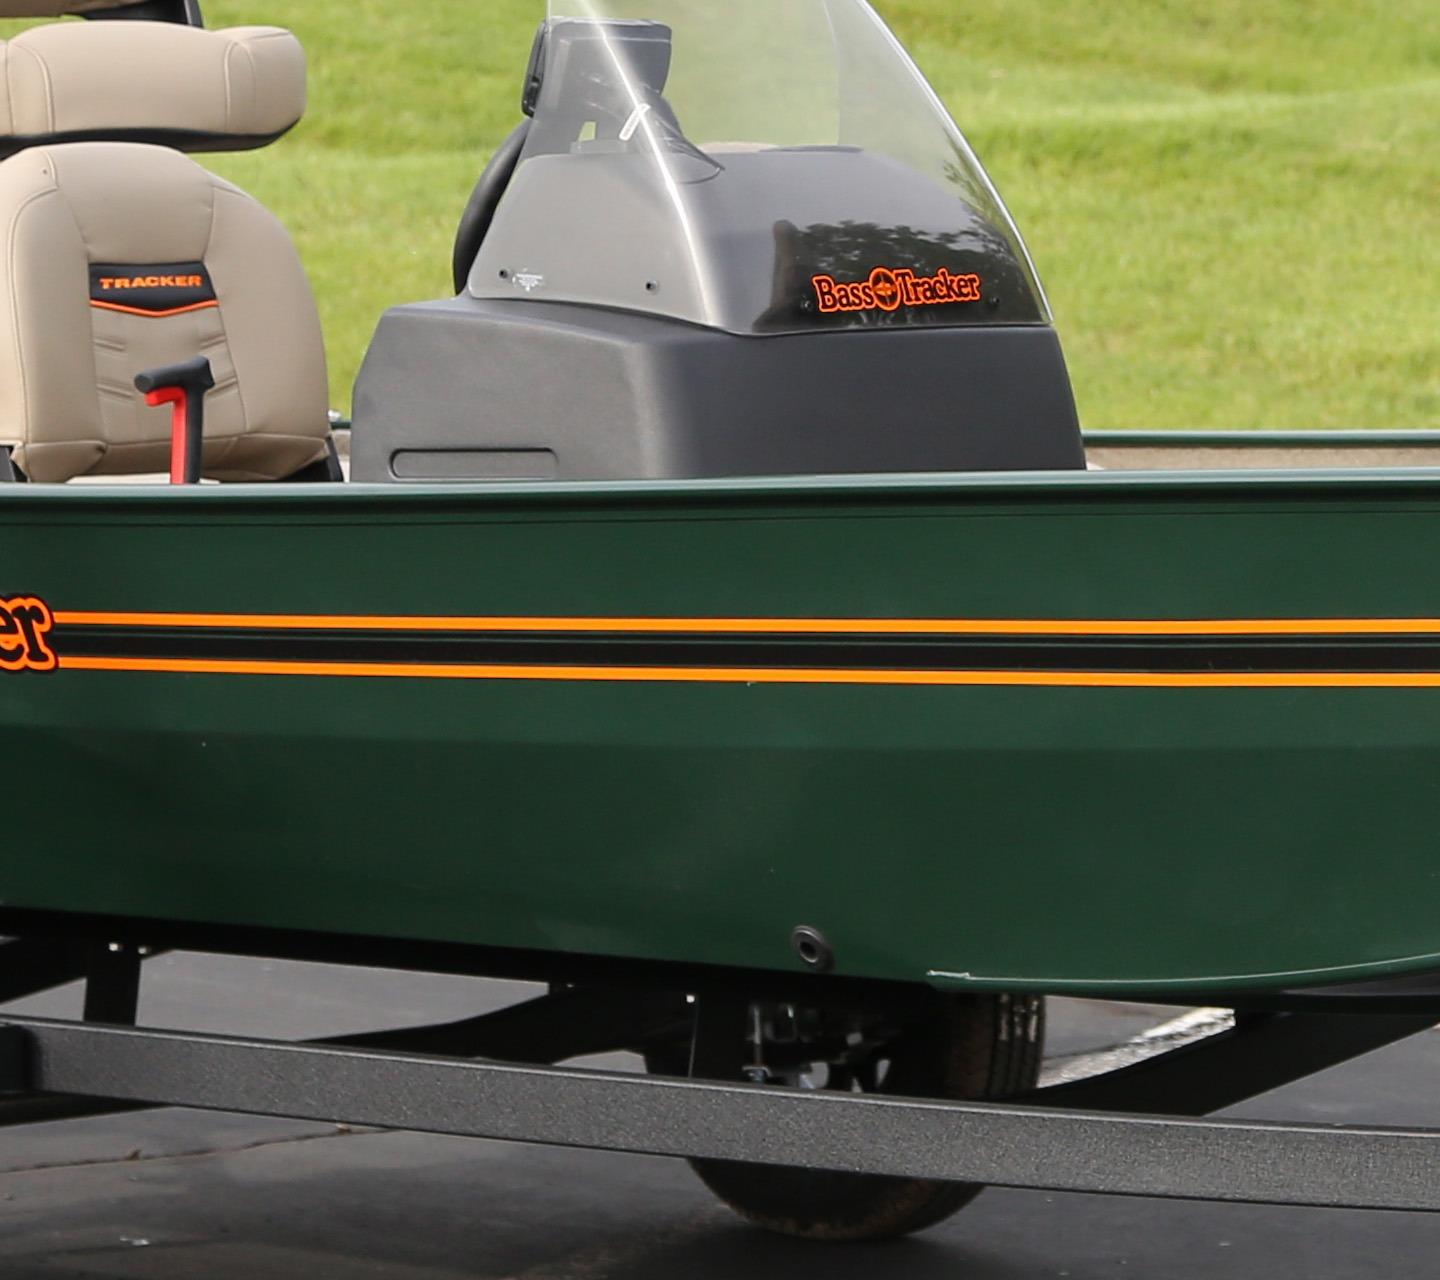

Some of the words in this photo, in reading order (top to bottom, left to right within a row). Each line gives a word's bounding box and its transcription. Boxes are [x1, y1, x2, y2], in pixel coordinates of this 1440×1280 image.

[100, 275, 203, 290] TRACKER
[812, 275, 877, 313] Bass
[893, 268, 981, 306] Tracker
